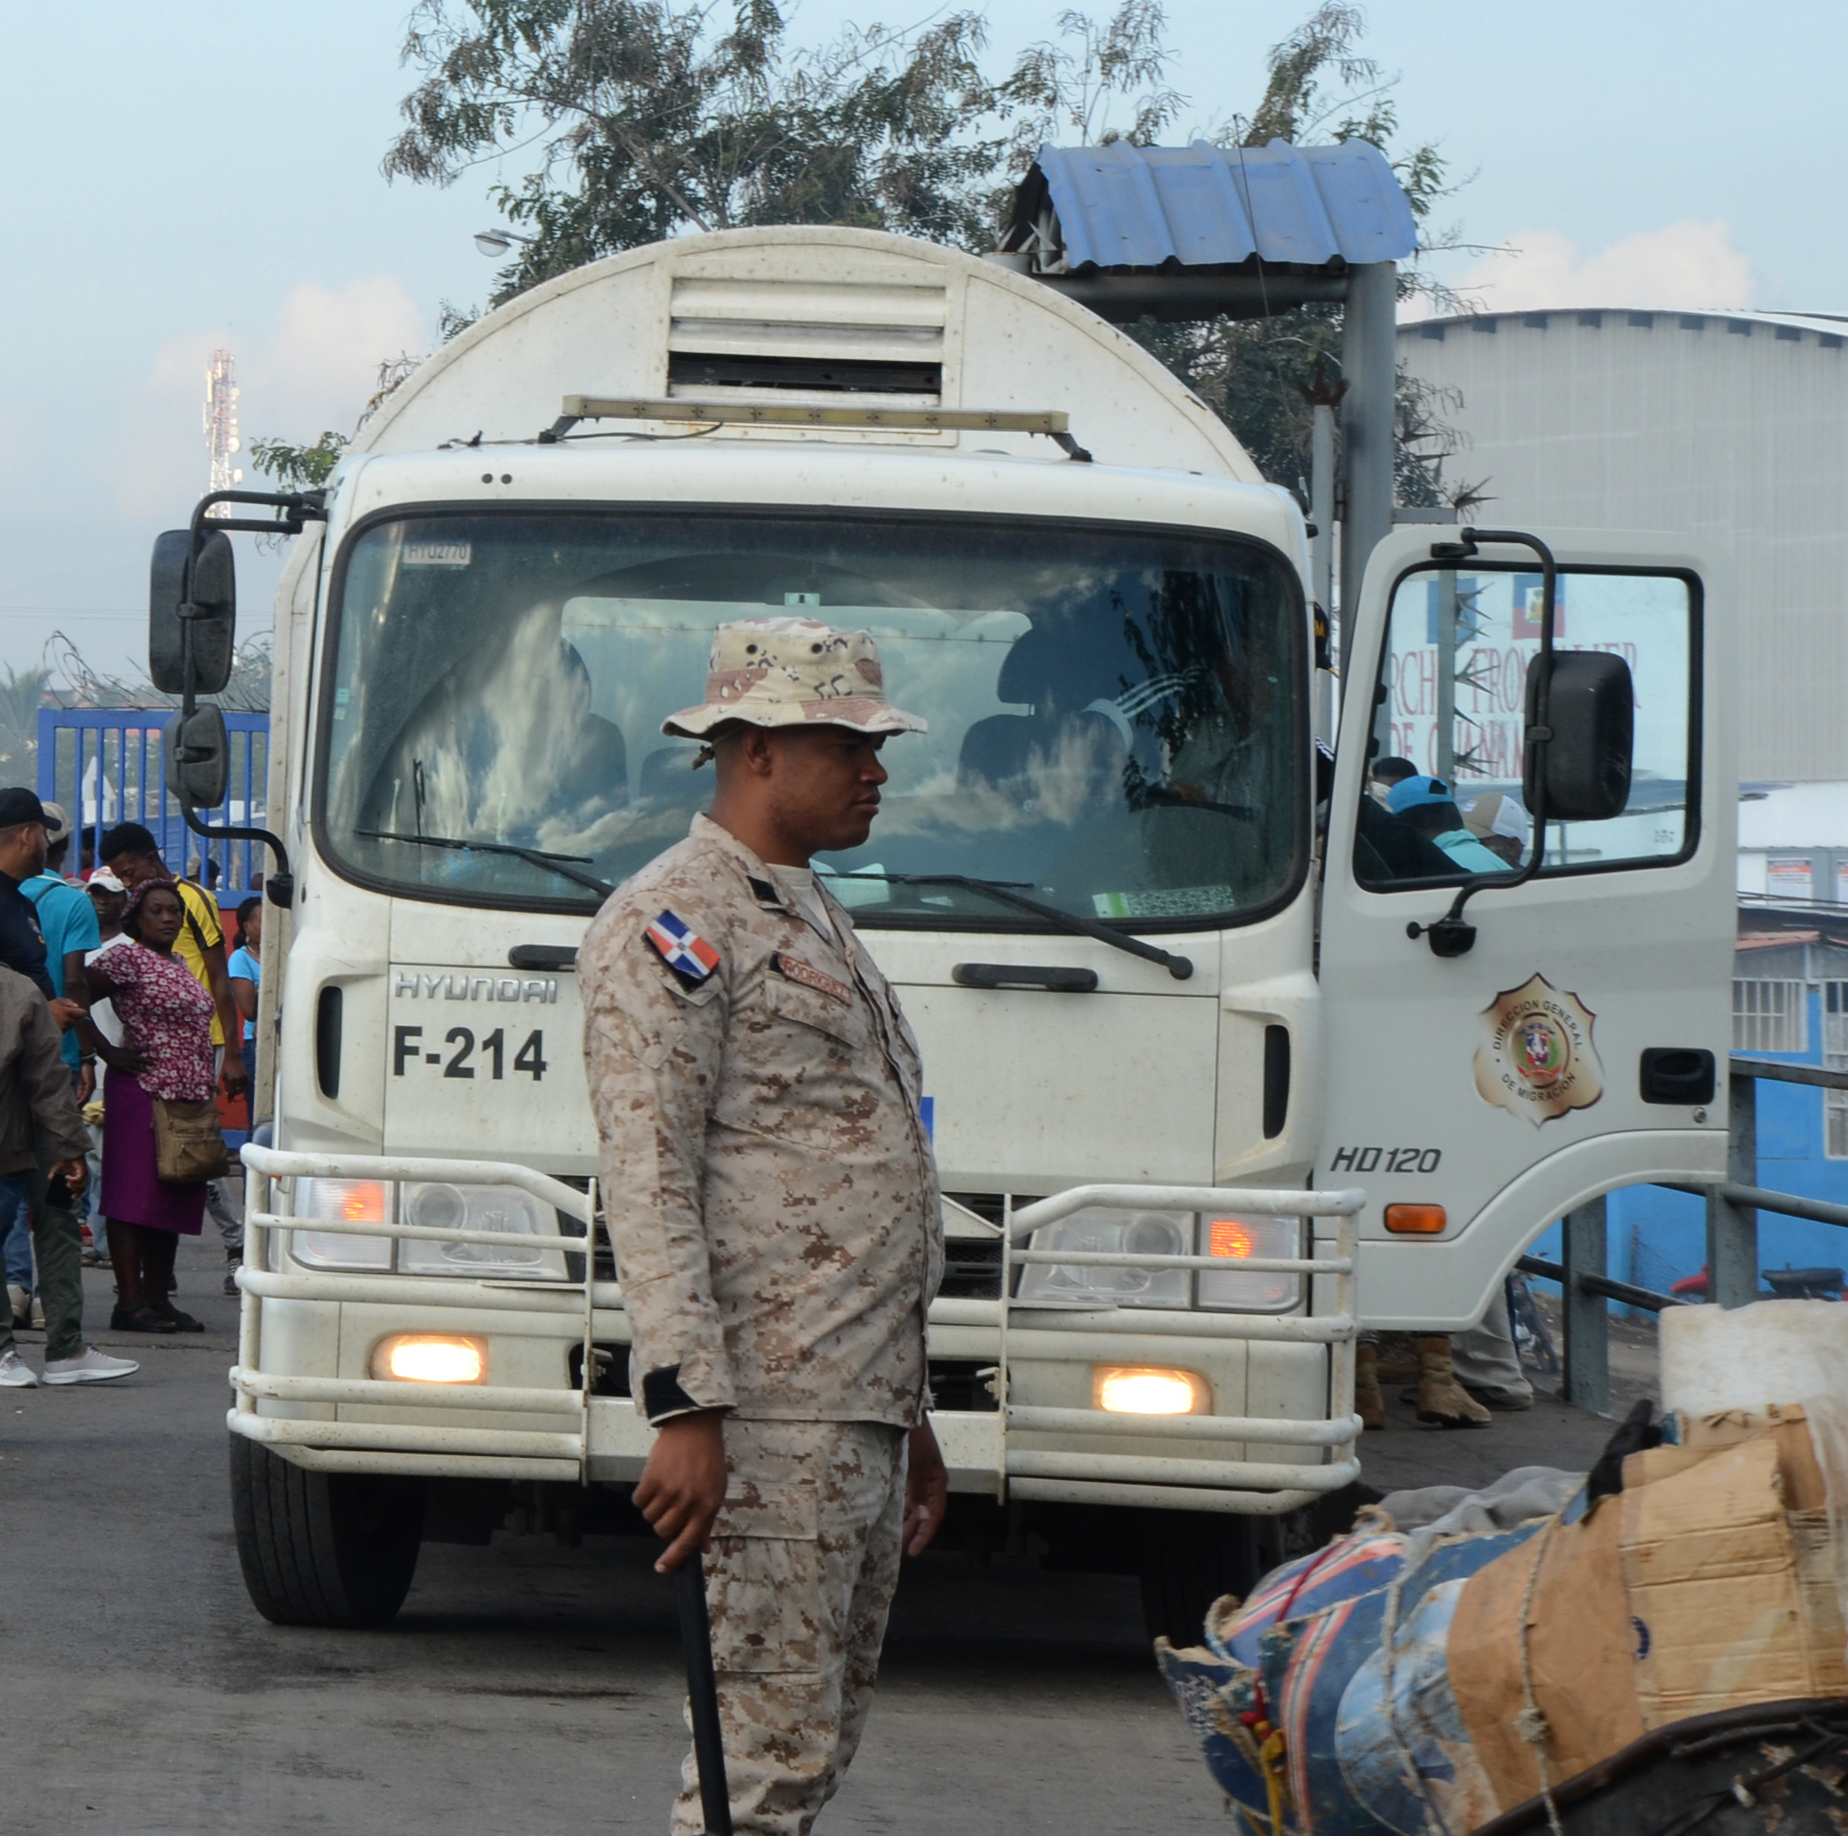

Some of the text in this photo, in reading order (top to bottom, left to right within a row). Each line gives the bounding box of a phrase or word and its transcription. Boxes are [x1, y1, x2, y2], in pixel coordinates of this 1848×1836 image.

[395, 971, 558, 1004] HYUNDAI
[1493, 999, 1583, 1051] DIRECCION GENERAL
[393, 1025, 548, 1081] F-214
[1501, 1072, 1577, 1102] DE MIGRACION
[1329, 1146, 1442, 1173] HD120
